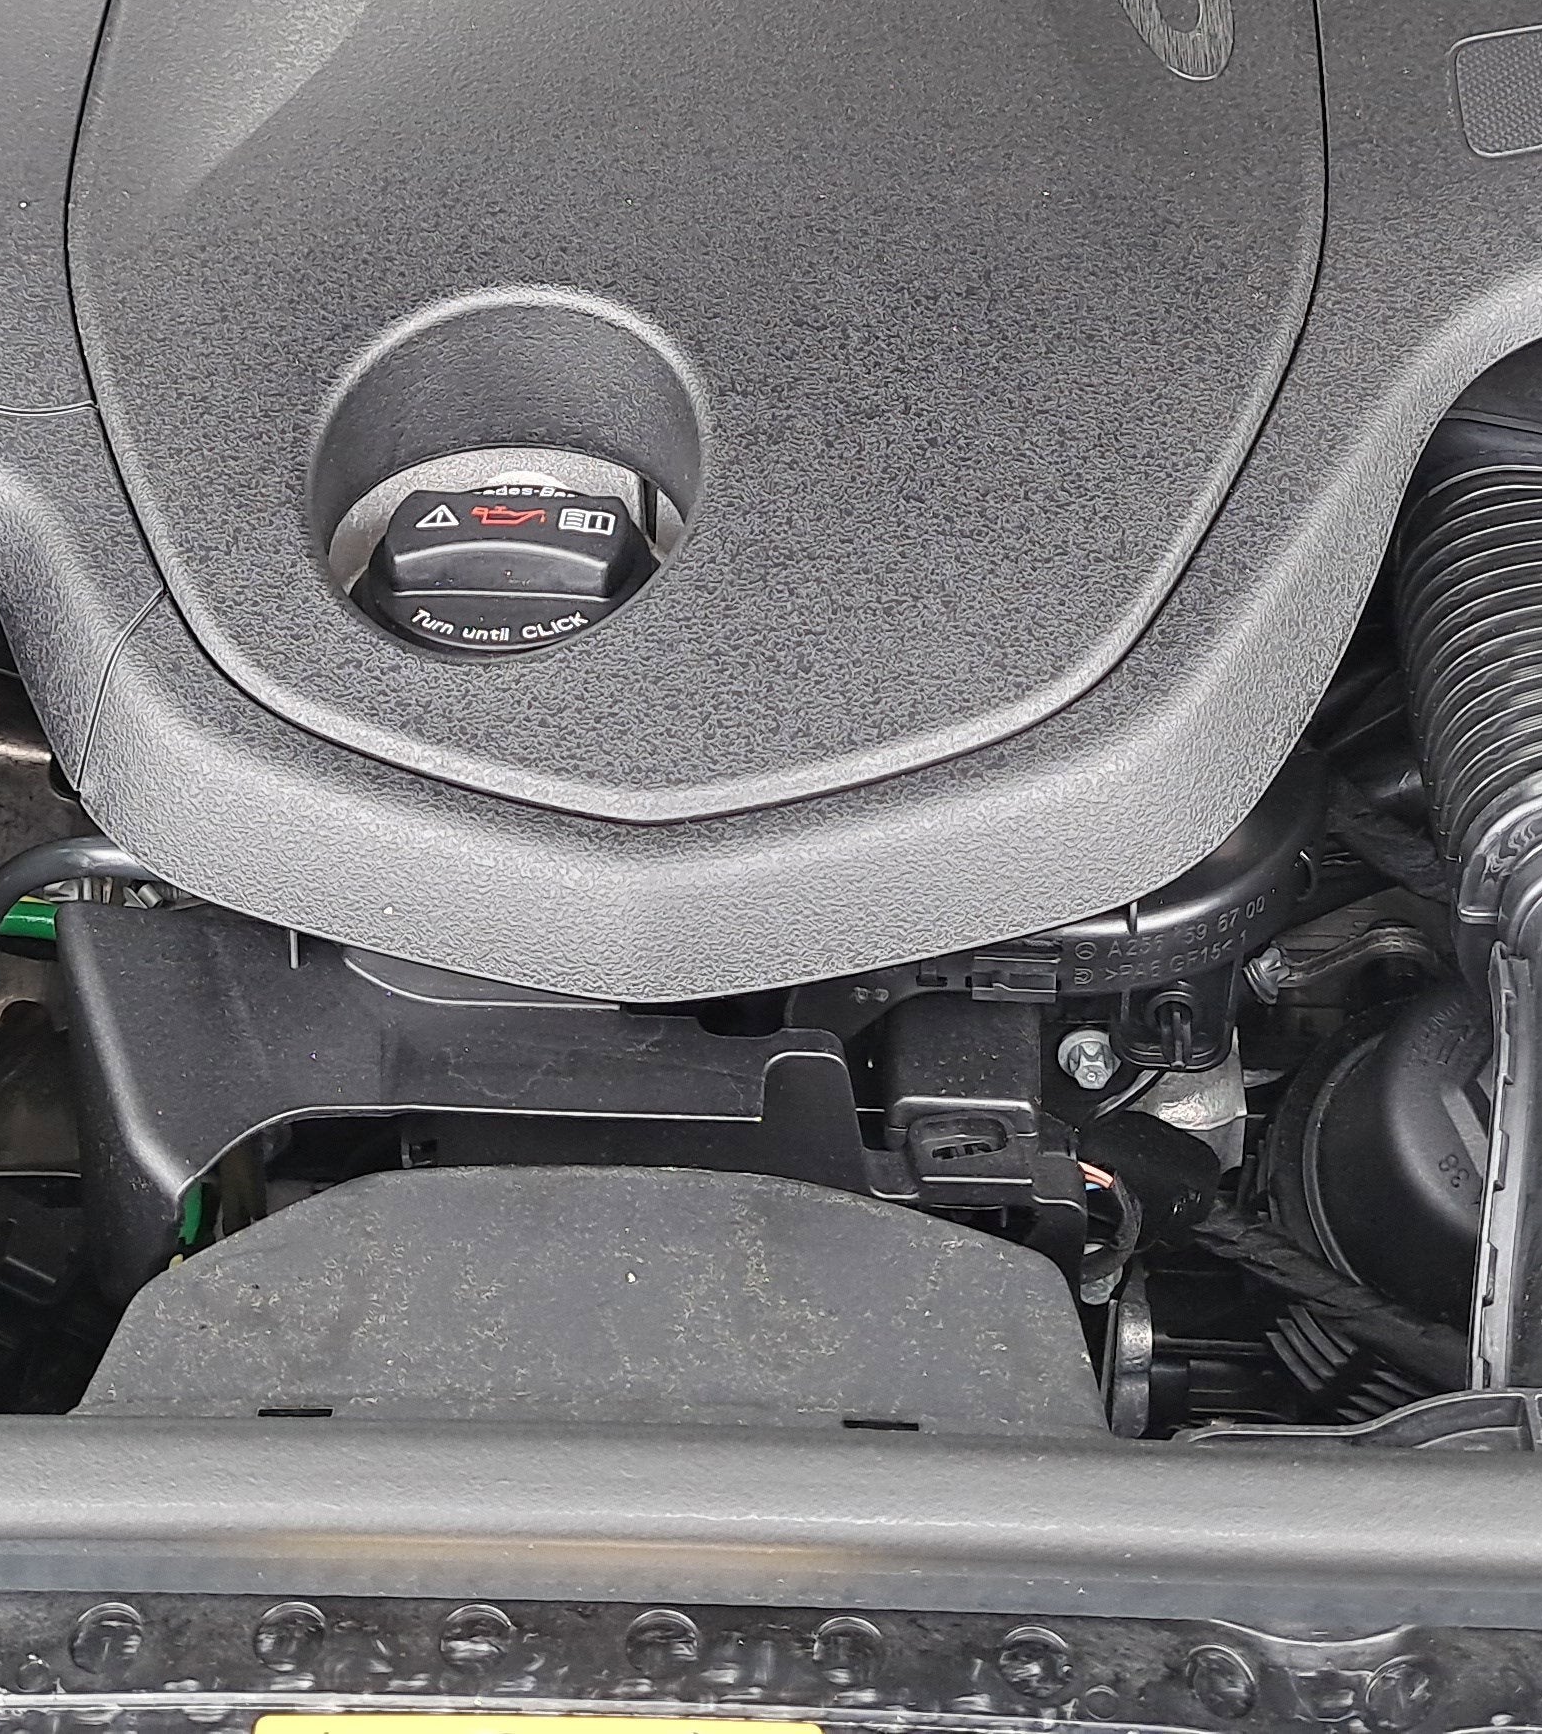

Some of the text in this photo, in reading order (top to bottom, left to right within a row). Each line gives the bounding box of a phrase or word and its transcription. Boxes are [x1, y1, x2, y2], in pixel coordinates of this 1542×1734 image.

[412, 608, 589, 642] Turn until CLICK
